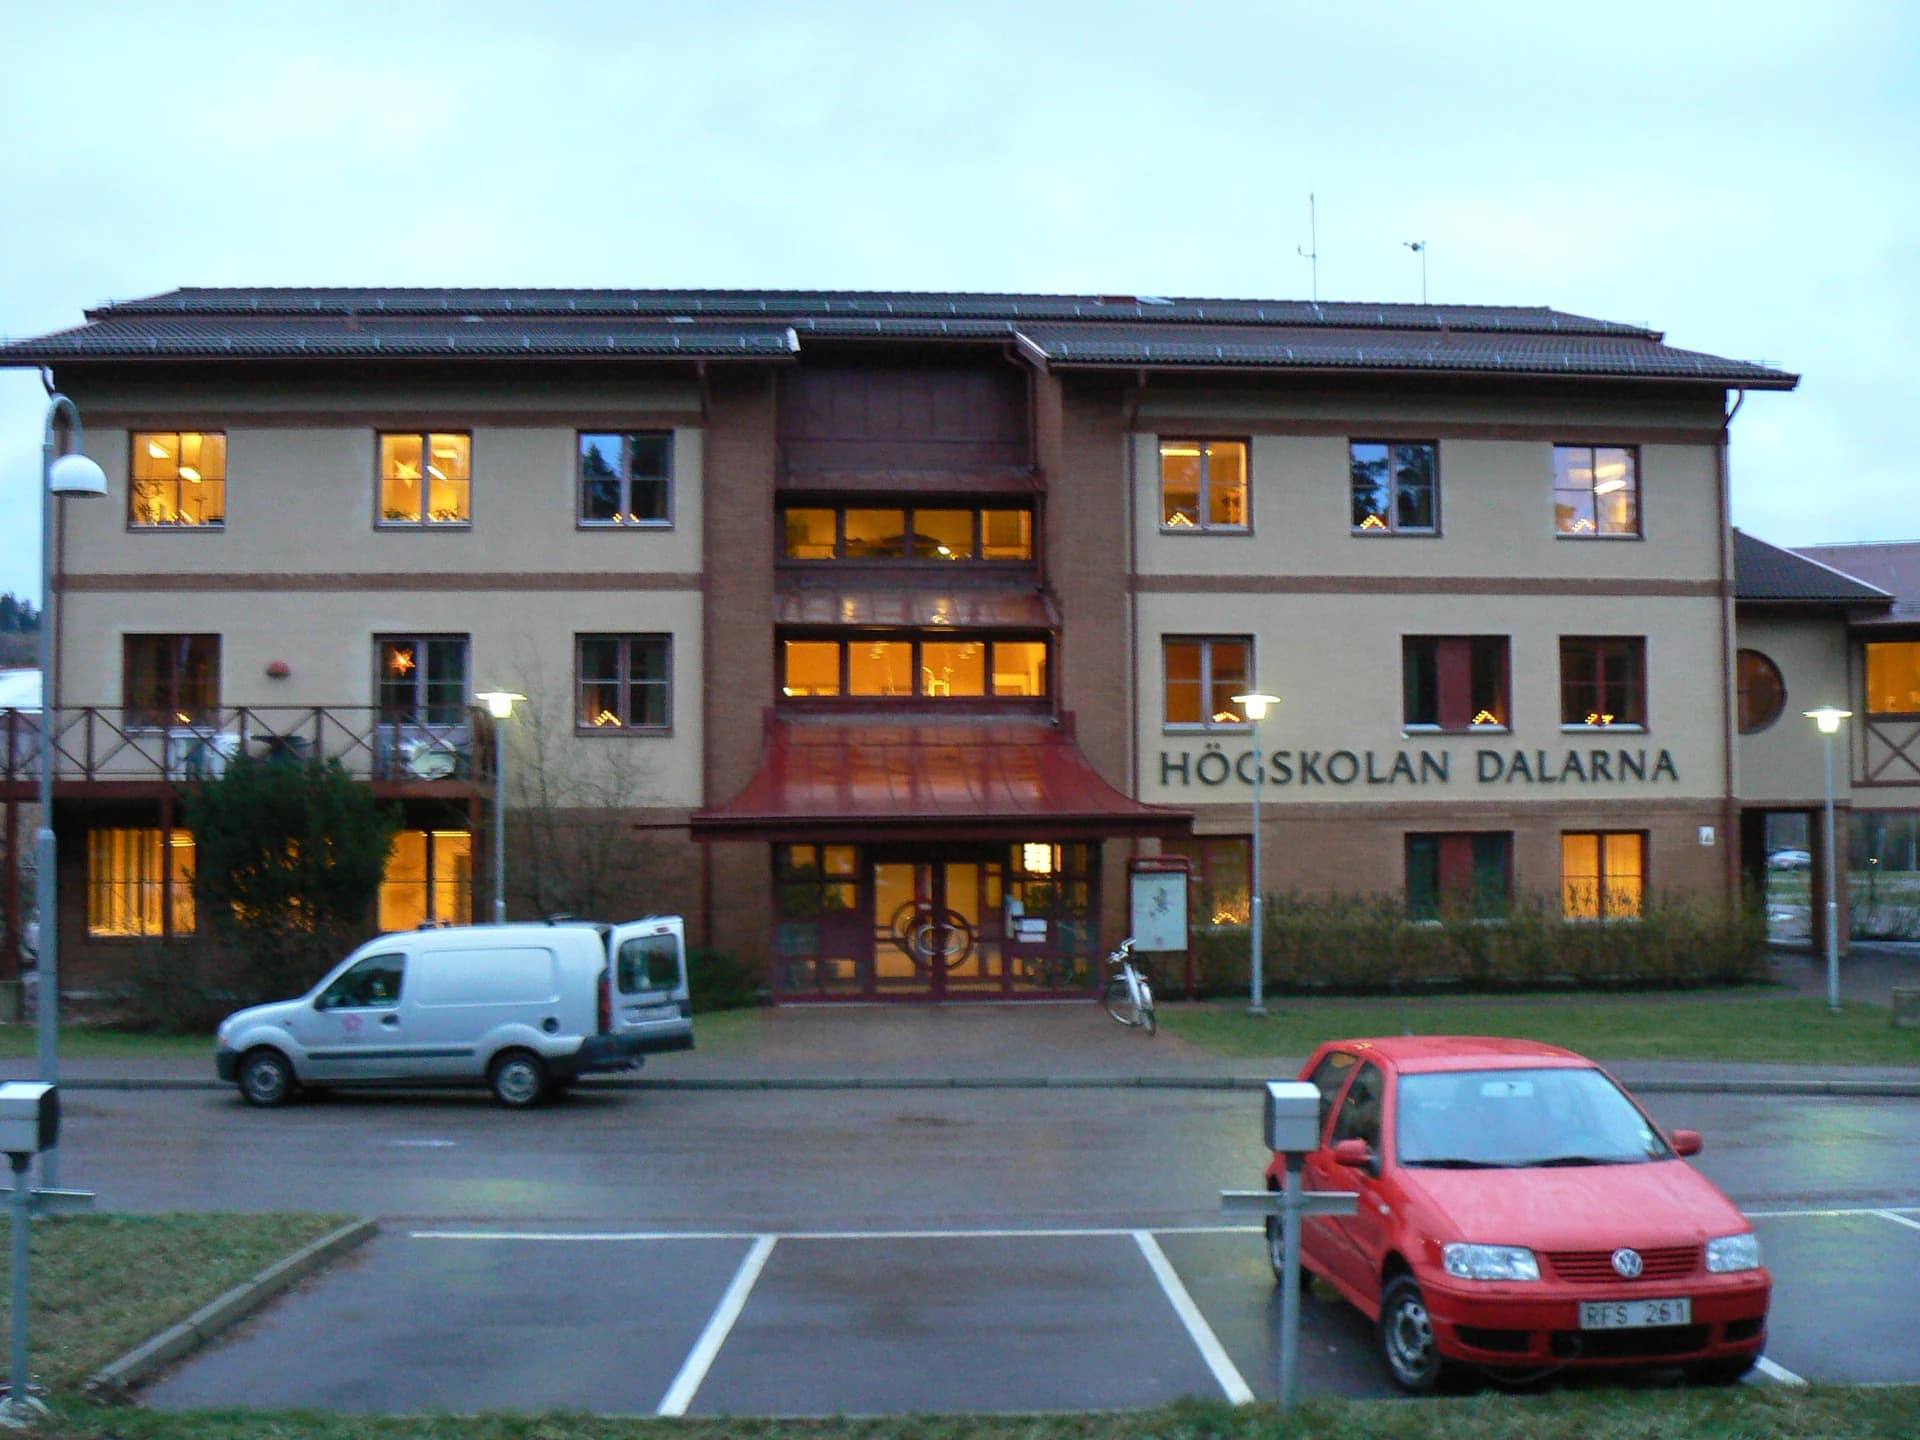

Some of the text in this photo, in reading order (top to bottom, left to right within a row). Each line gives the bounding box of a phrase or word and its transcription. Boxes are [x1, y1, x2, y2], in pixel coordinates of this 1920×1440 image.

[1160, 743, 1679, 785] HÖGSKOLAN DALARNA
[1586, 1302, 1684, 1325] RFS 261
